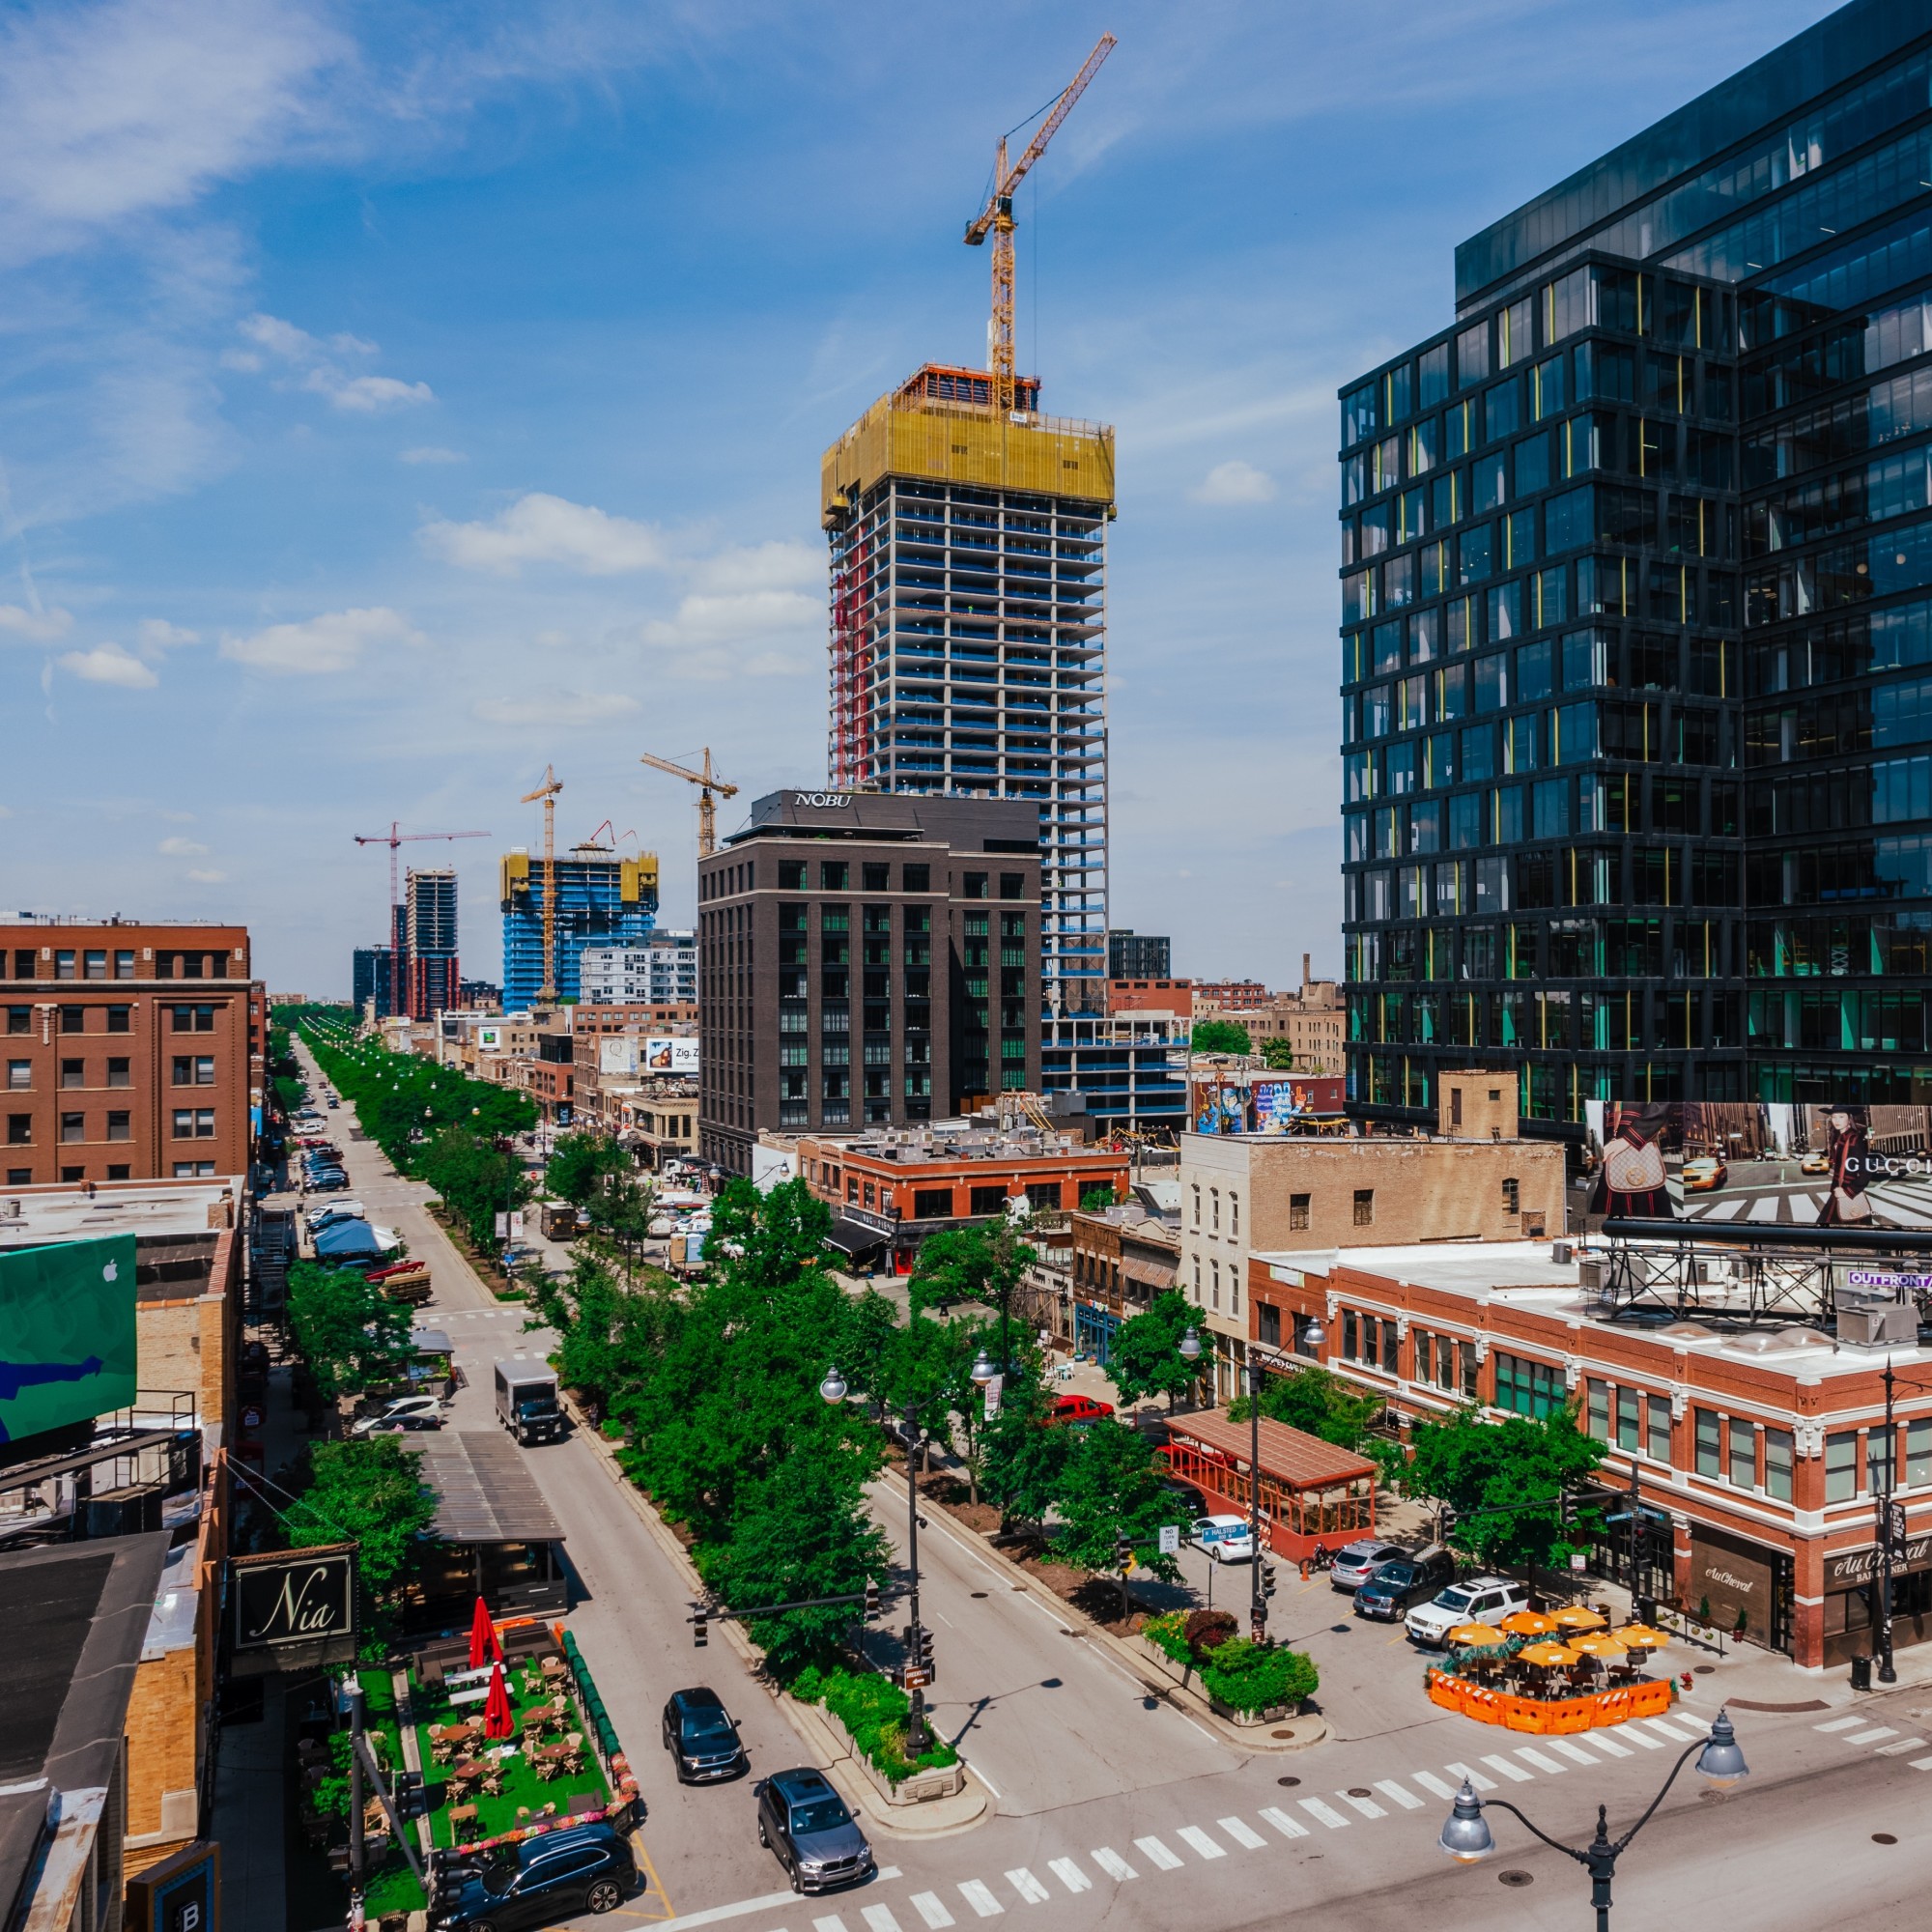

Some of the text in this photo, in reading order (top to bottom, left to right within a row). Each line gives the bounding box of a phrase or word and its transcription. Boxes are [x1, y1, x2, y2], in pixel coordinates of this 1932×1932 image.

[794, 793, 852, 808] NOBU
[676, 1048, 692, 1059] Zig.
[1845, 1157, 1931, 1174] GUCCI
[1212, 1526, 1236, 1536] HALSTED
[1834, 1555, 1862, 1577] Au
[249, 1567, 335, 1636] Nia
